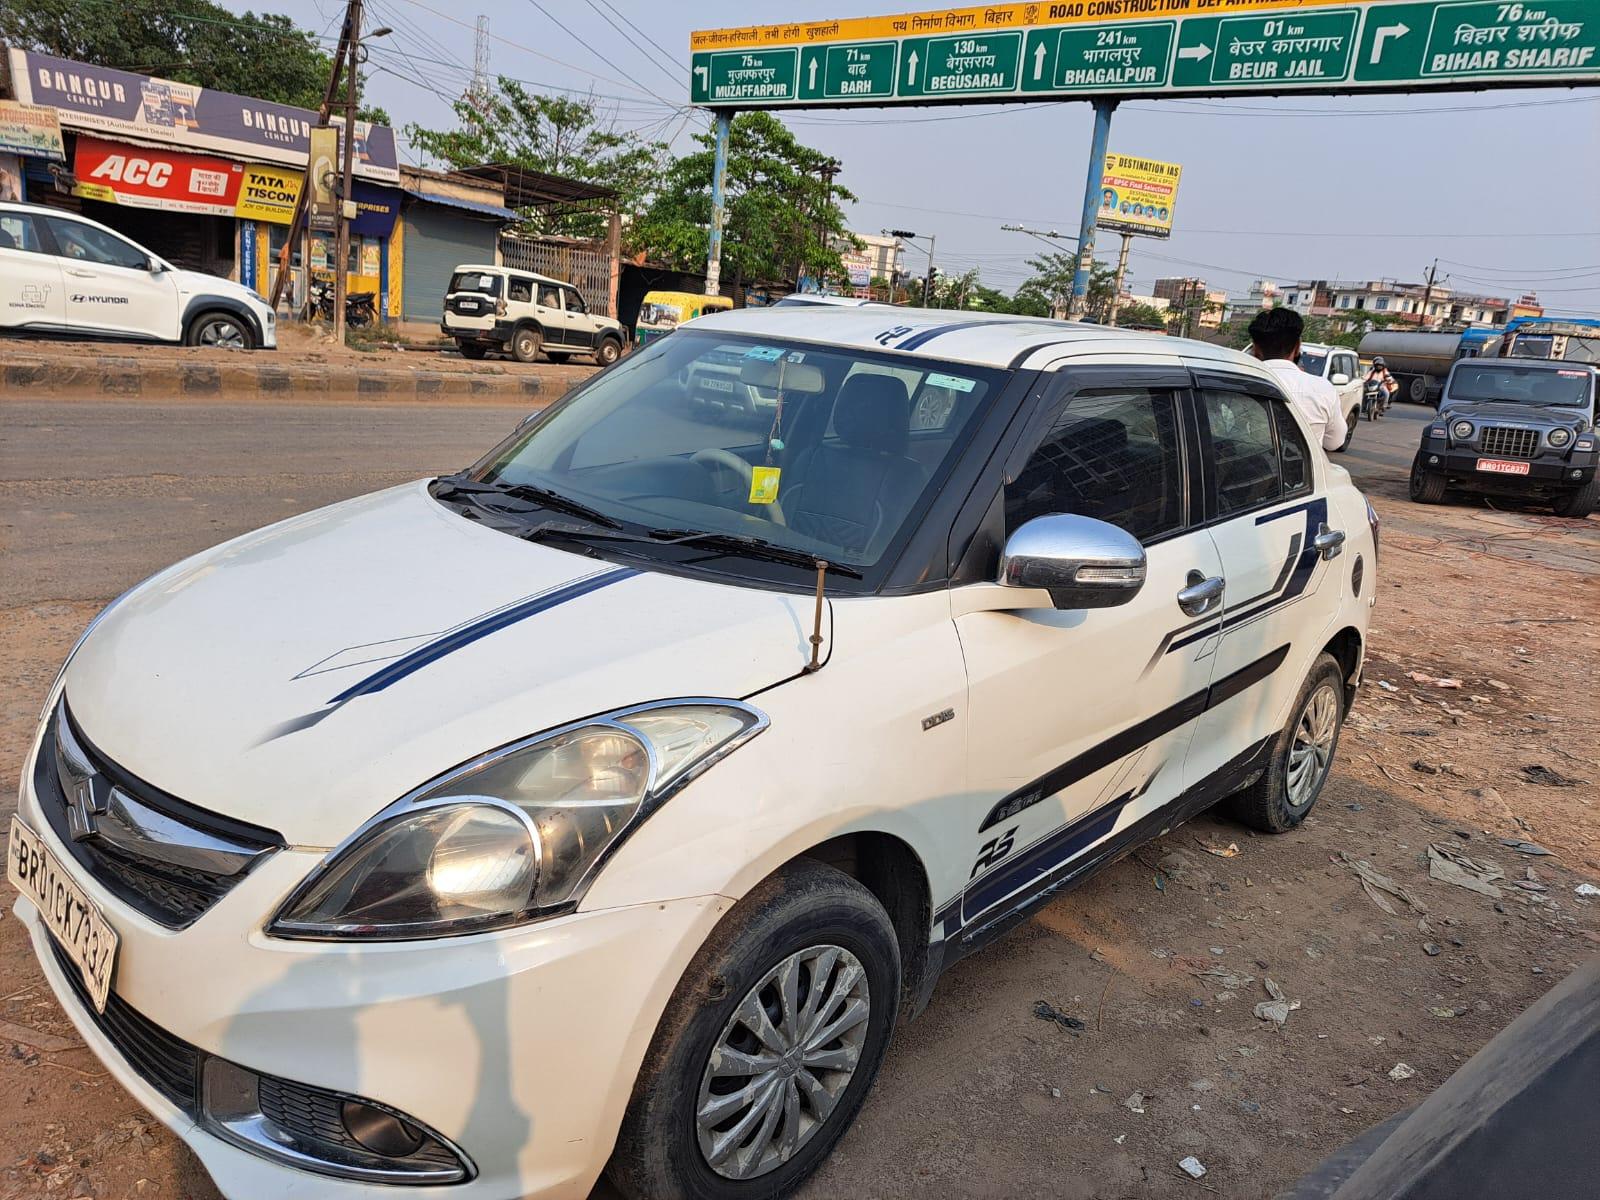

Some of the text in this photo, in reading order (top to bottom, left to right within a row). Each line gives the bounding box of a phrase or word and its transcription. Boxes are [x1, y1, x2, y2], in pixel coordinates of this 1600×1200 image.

[1049, 5, 1083, 18] ROAD
[1087, 0, 1189, 16] CONSTRUCTION
[1495, 4, 1546, 23] 76 km
[892, 20, 907, 32] पथ
[912, 14, 942, 30] निर्माण
[984, 8, 1014, 24] बिहार
[1263, 20, 1305, 37] 01 km
[764, 28, 779, 39] तभी
[783, 25, 800, 39] होगी
[806, 22, 839, 40] खुशहाली
[1097, 30, 1137, 46] 241 km
[1453, 17, 1584, 46] बिहार शरीफ
[954, 40, 988, 54] 130 km
[1228, 36, 1344, 56] बेउर कारागार
[742, 55, 763, 67] 75 km
[846, 49, 871, 62] 71 km
[946, 53, 996, 74] बेगुसराय
[1083, 47, 1142, 66] भागलपुर
[1431, 46, 1596, 72] BIHAR SHARIF
[1065, 66, 1157, 85] BHAGALPUR
[1229, 59, 1324, 79] BEUR JAIL
[38, 67, 127, 104] BANGUR
[840, 80, 872, 94] BARH
[931, 73, 1004, 90] BEGUSARAI
[715, 84, 787, 98] MUZAFFARPUR
[66, 93, 104, 109] CEMENT
[242, 108, 310, 139] BANGUR
[264, 131, 294, 144] CEMENT
[90, 154, 173, 188] ACC
[1118, 157, 1179, 177] DESTINATION IAS
[250, 174, 285, 189] TATA
[246, 186, 297, 204] TISCON
[88, 296, 129, 304] HYUNDAI
